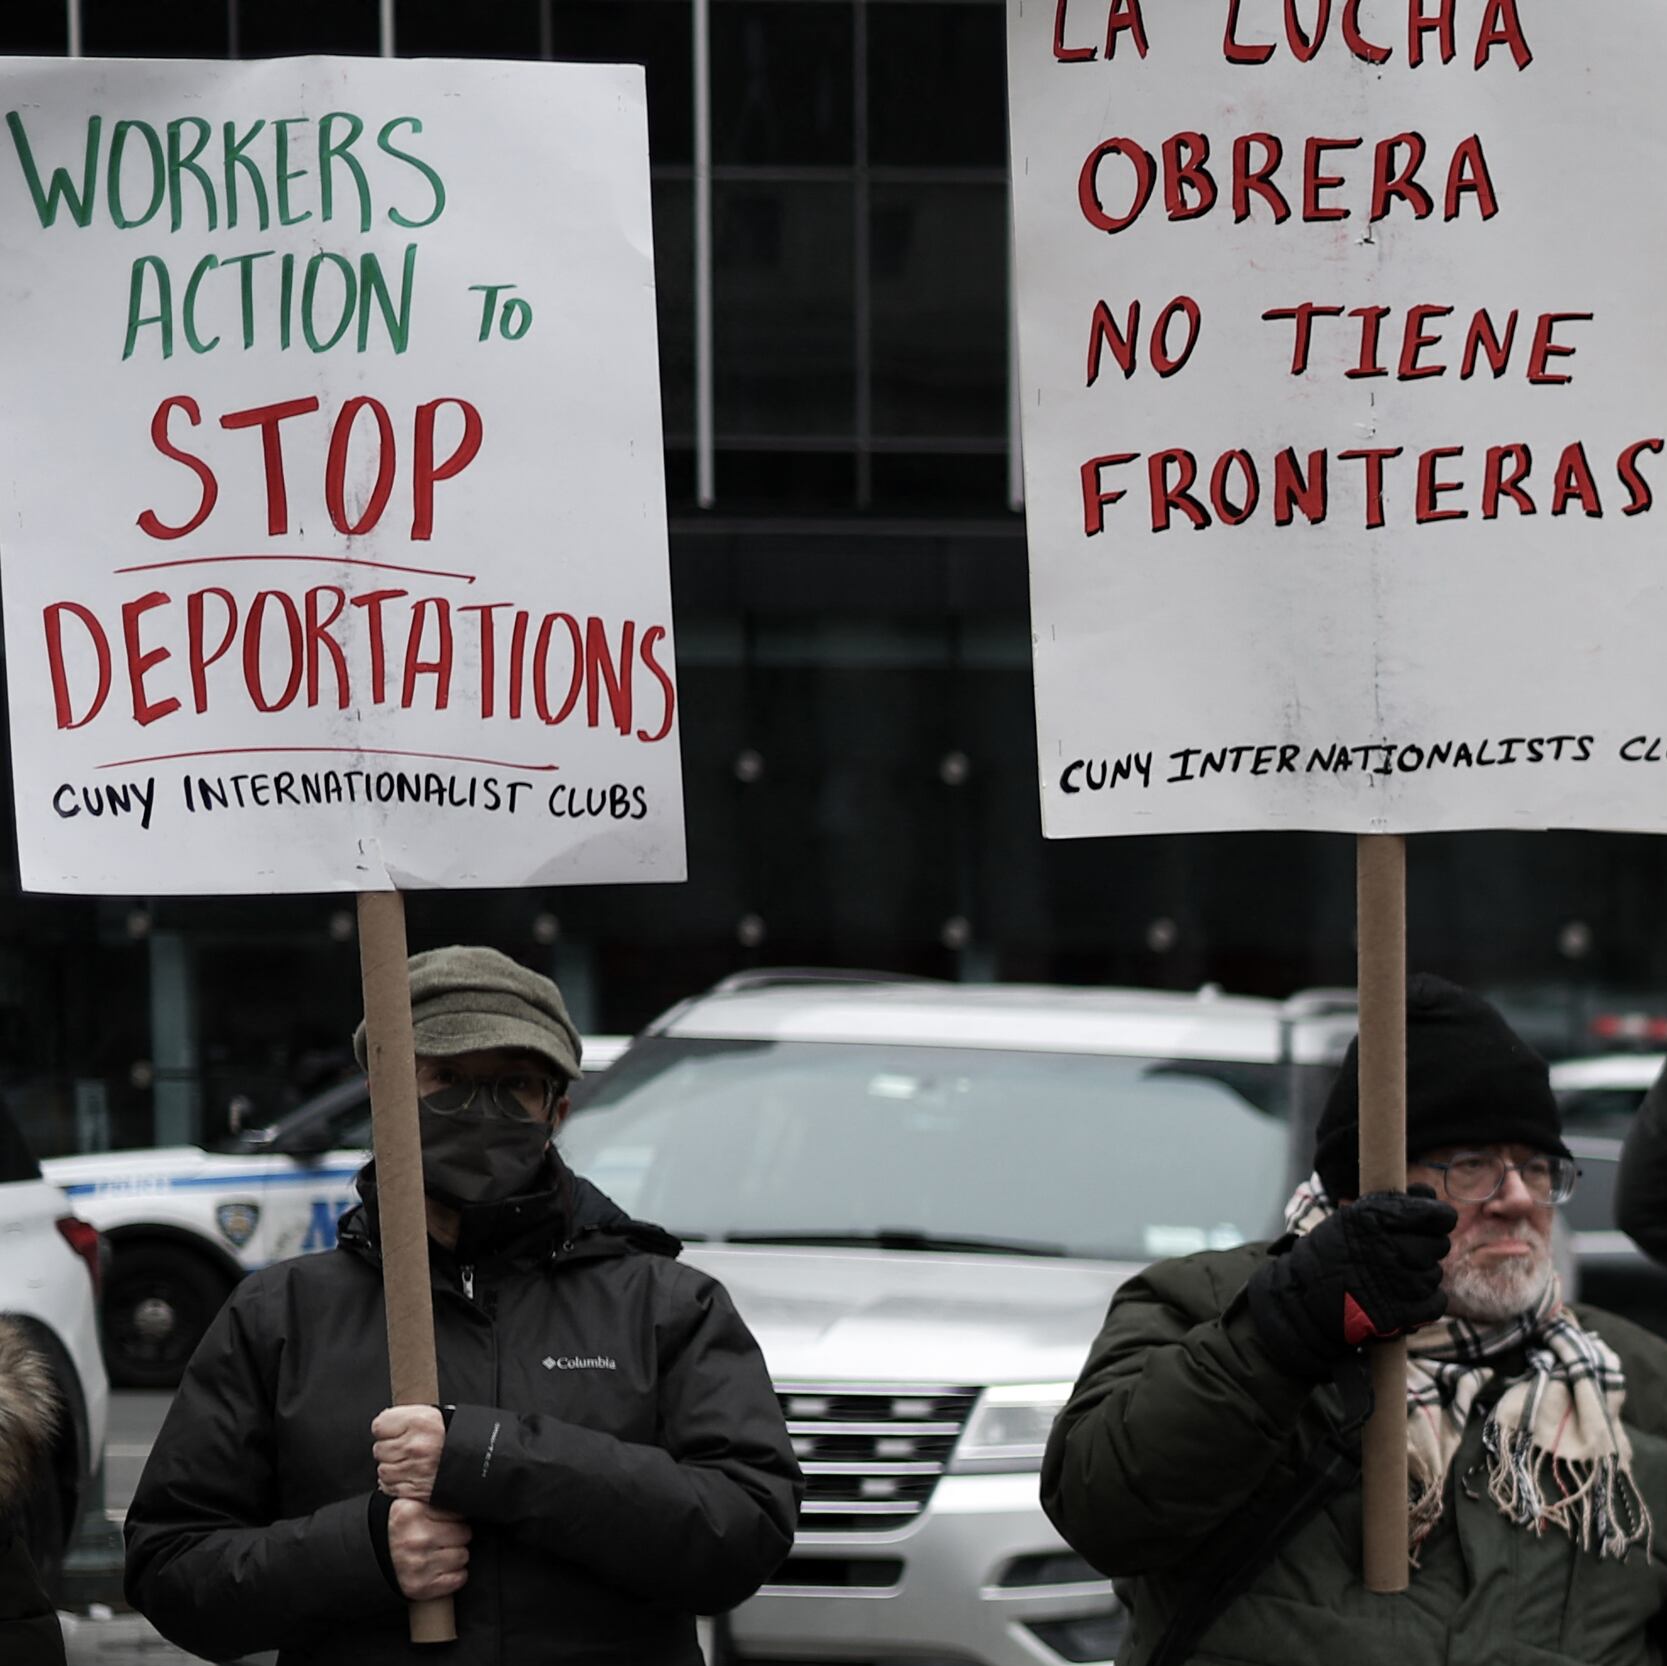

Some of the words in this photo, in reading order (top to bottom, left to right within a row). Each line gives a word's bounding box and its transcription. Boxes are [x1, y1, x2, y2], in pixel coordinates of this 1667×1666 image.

[1053, 0, 1149, 62] LA
[1222, 0, 1532, 69] LUCHA
[7, 111, 446, 232] WORKERS
[1078, 131, 1499, 232] OBRERA
[125, 244, 416, 357] ACTION
[1086, 295, 1200, 385] NO
[1263, 302, 1594, 384] TIENE
[139, 396, 483, 540] STOP
[44, 586, 675, 742] DEPORTATIONS
[53, 778, 154, 829] CUNY
[184, 771, 532, 813] INTERNATIONALIST
[549, 784, 647, 819] CLUBS
[1060, 752, 1152, 793] CUNY
[1167, 736, 1593, 782] INTERNATIONALISTS
[556, 1356, 616, 1370] Columbia
